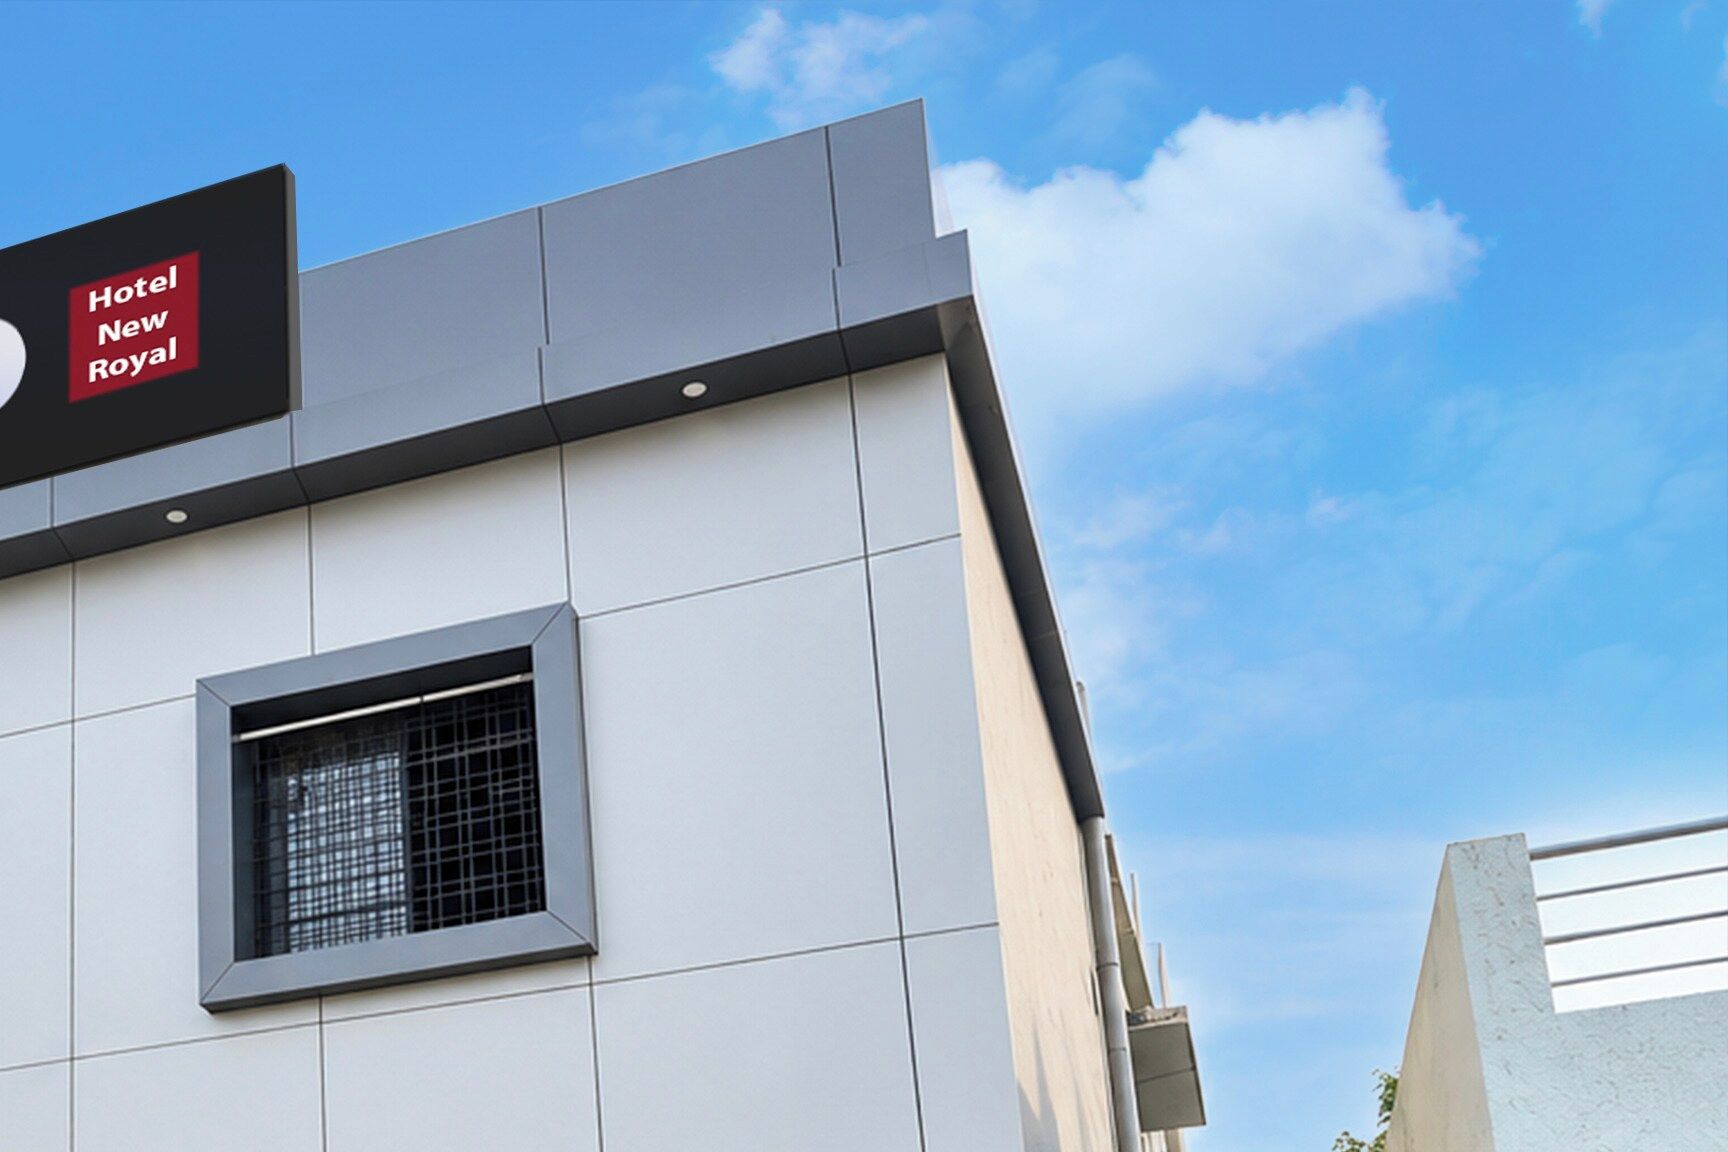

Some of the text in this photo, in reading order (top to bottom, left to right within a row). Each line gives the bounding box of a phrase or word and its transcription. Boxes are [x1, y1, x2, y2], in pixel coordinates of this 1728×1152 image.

[88, 265, 177, 313] Hotel
[98, 310, 170, 346] New
[88, 336, 177, 383] Royal
